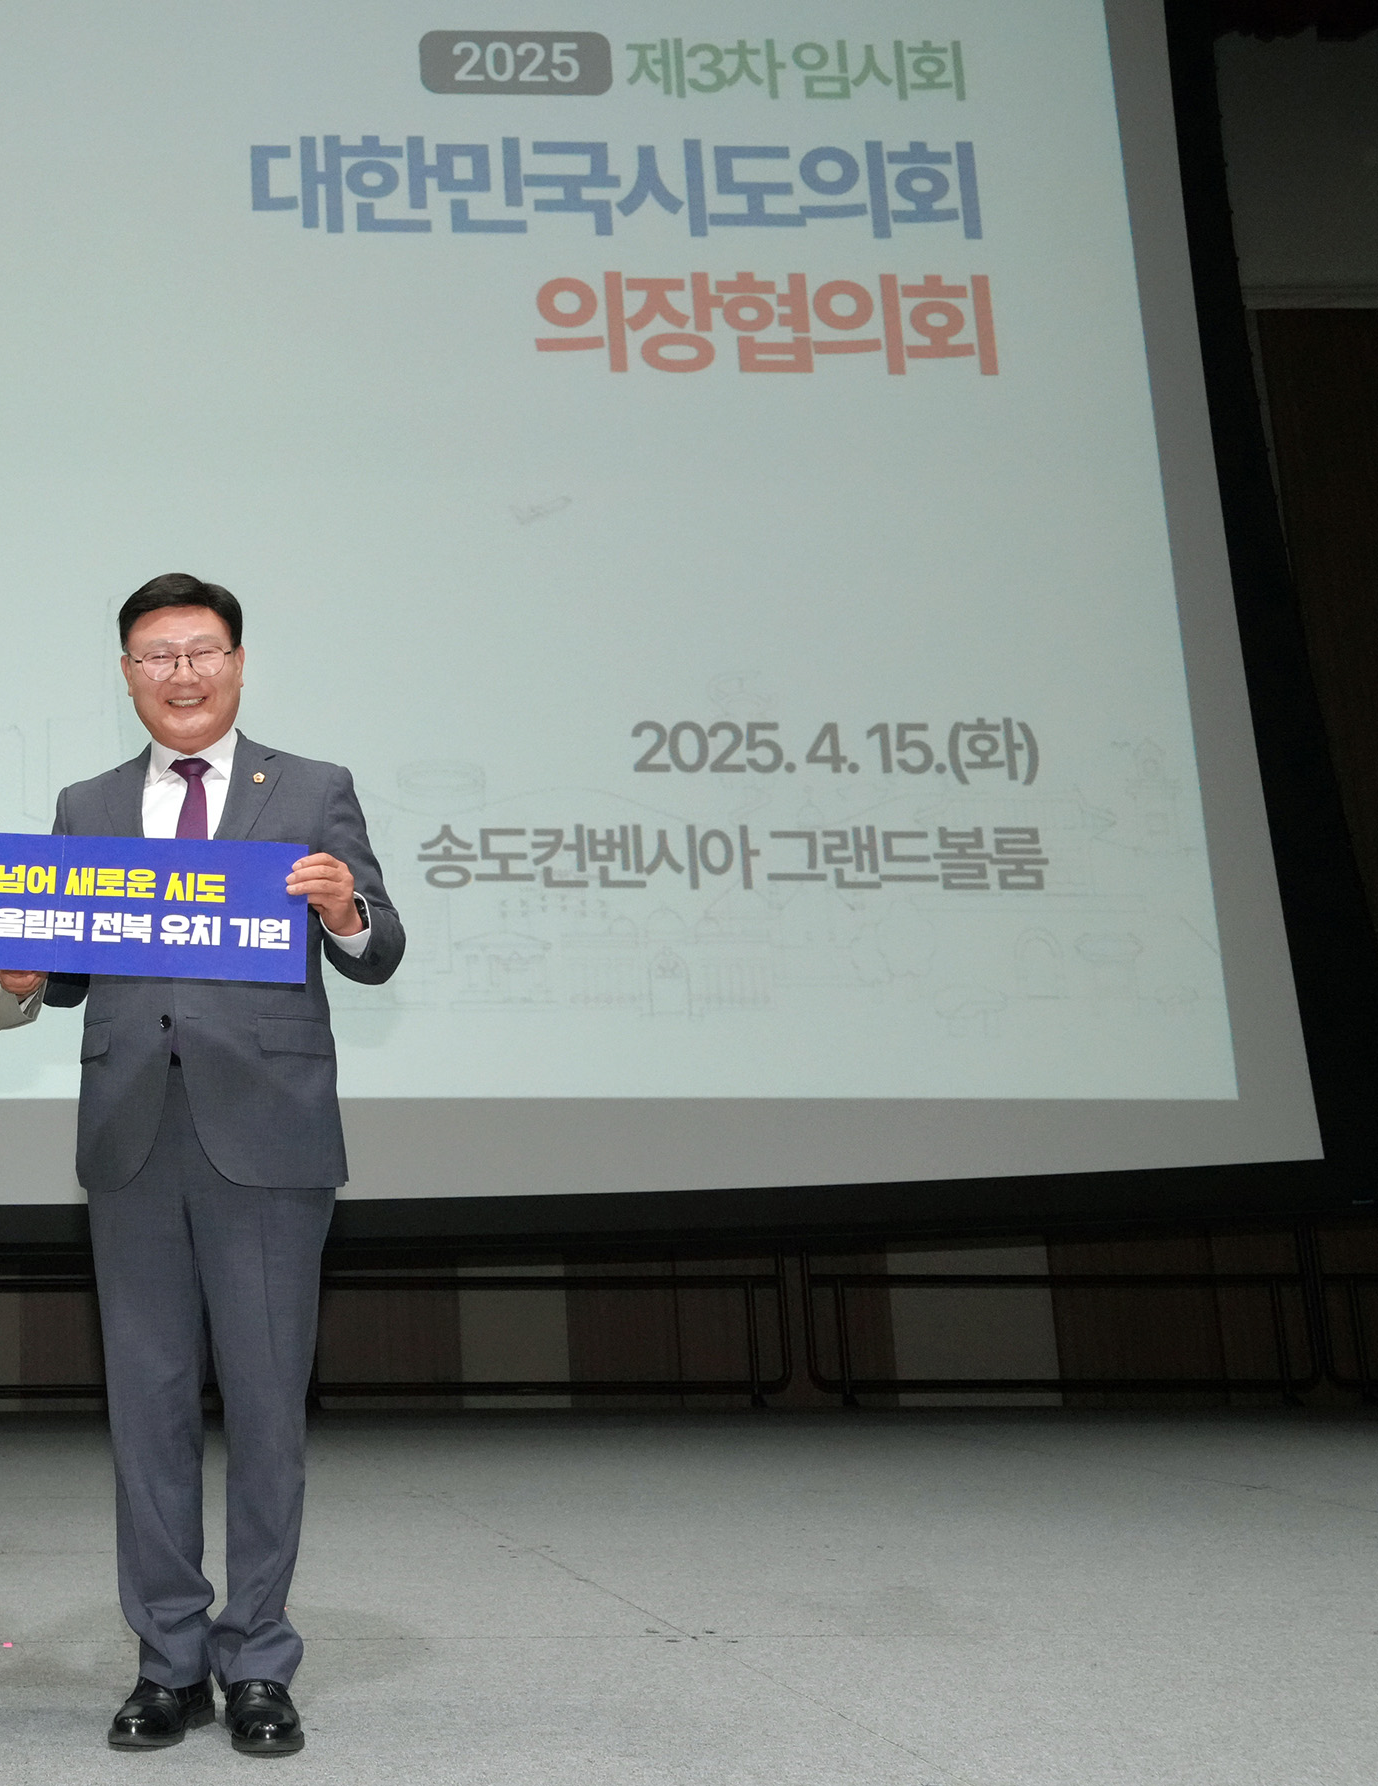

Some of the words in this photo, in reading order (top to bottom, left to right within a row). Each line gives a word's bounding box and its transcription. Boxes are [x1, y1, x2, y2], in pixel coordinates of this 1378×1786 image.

[451, 41, 580, 82] 2025
[626, 37, 785, 99] 제3차
[791, 39, 967, 100] 임시회
[250, 134, 983, 239] 대한민국시도의회
[534, 271, 999, 376] 의장협의회
[64, 867, 157, 900] 새로운
[163, 872, 227, 904] 시도
[417, 824, 760, 890] 송도컨벤시아
[767, 826, 1050, 890] 그랜드볼룸
[91, 911, 153, 944] 전북
[160, 915, 222, 947] 유치
[229, 917, 291, 950] 기원
